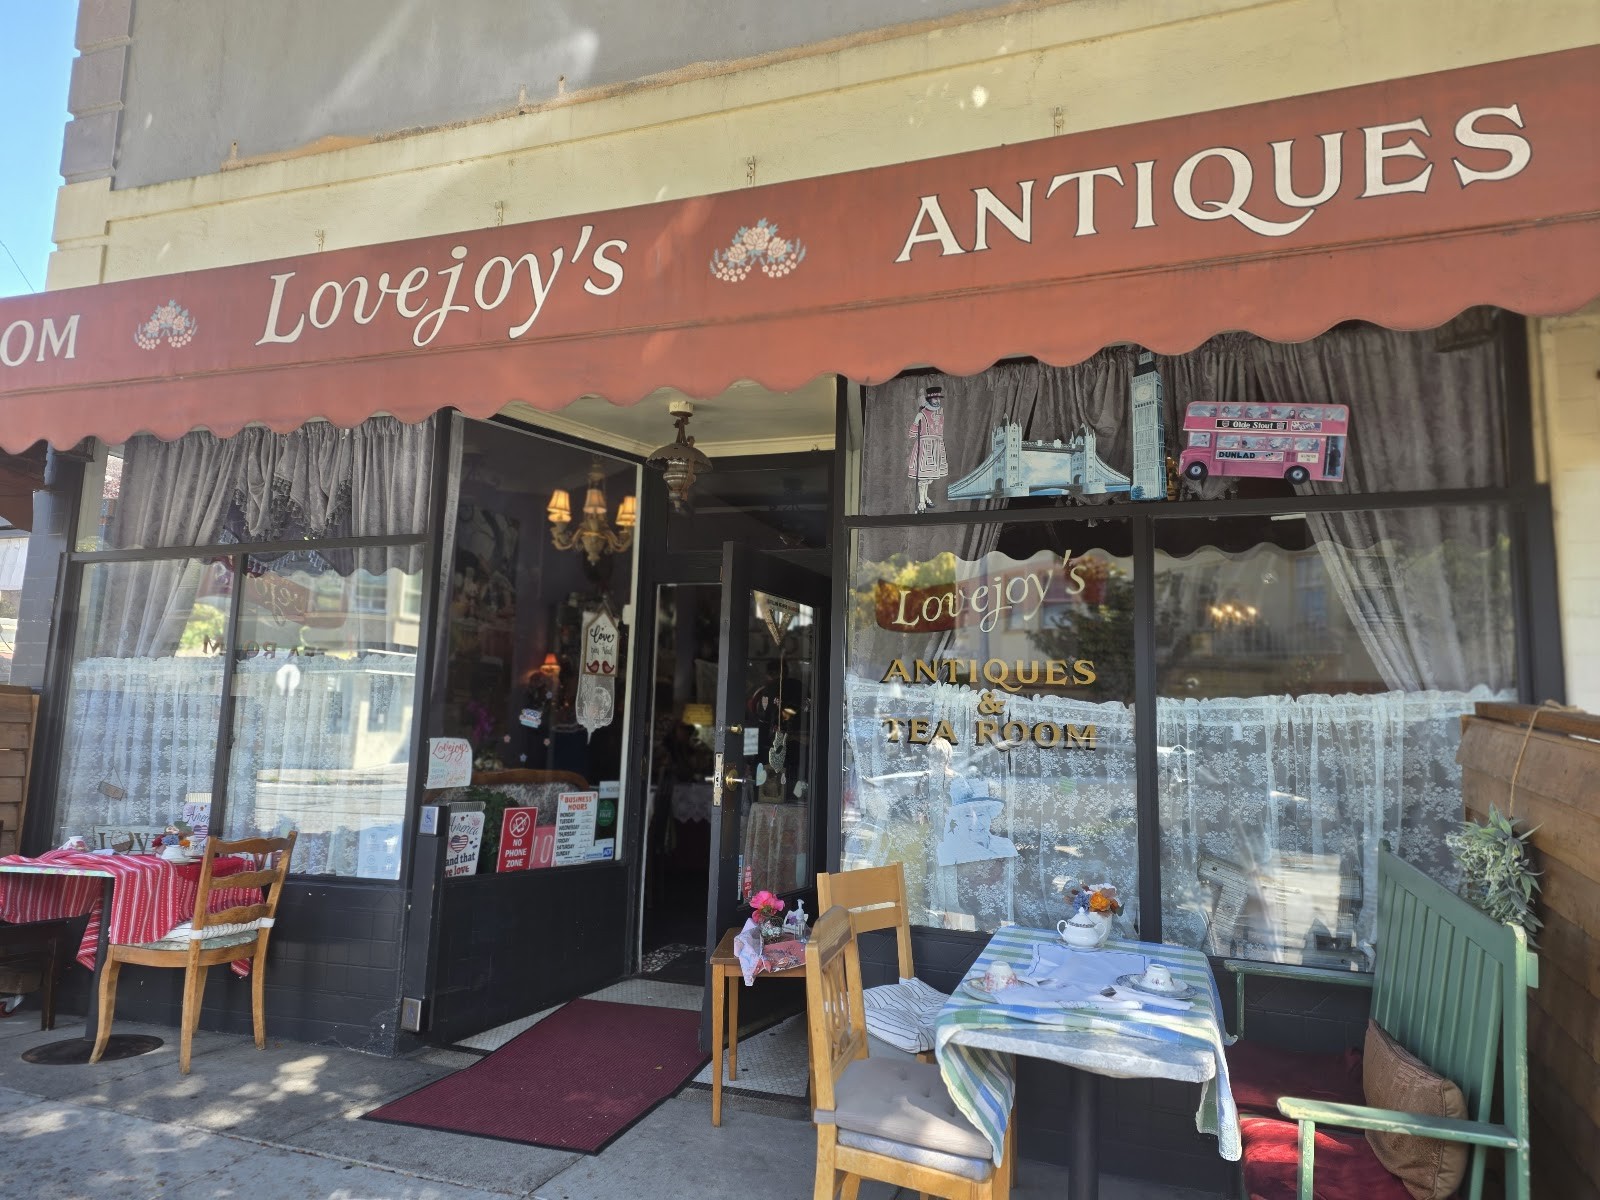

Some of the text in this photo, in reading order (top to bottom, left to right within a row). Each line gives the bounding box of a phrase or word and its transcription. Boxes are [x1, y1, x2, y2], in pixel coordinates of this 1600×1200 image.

[894, 103, 1533, 263] ANTIQUES
[255, 225, 629, 348] Lovejoy's
[1252, 421, 1273, 430] Stout
[1218, 451, 1256, 459] DUNLAD
[892, 549, 1087, 633] Lovejoy's
[880, 657, 1097, 693] ANTIQUES
[976, 691, 1007, 716] &
[882, 717, 1097, 751] TEA ROOM
[567, 803, 588, 811] HOURS
[512, 838, 523, 847] NO
[459, 852, 476, 863] that
[504, 847, 528, 858] PHONE
[505, 858, 524, 868] ZONE
